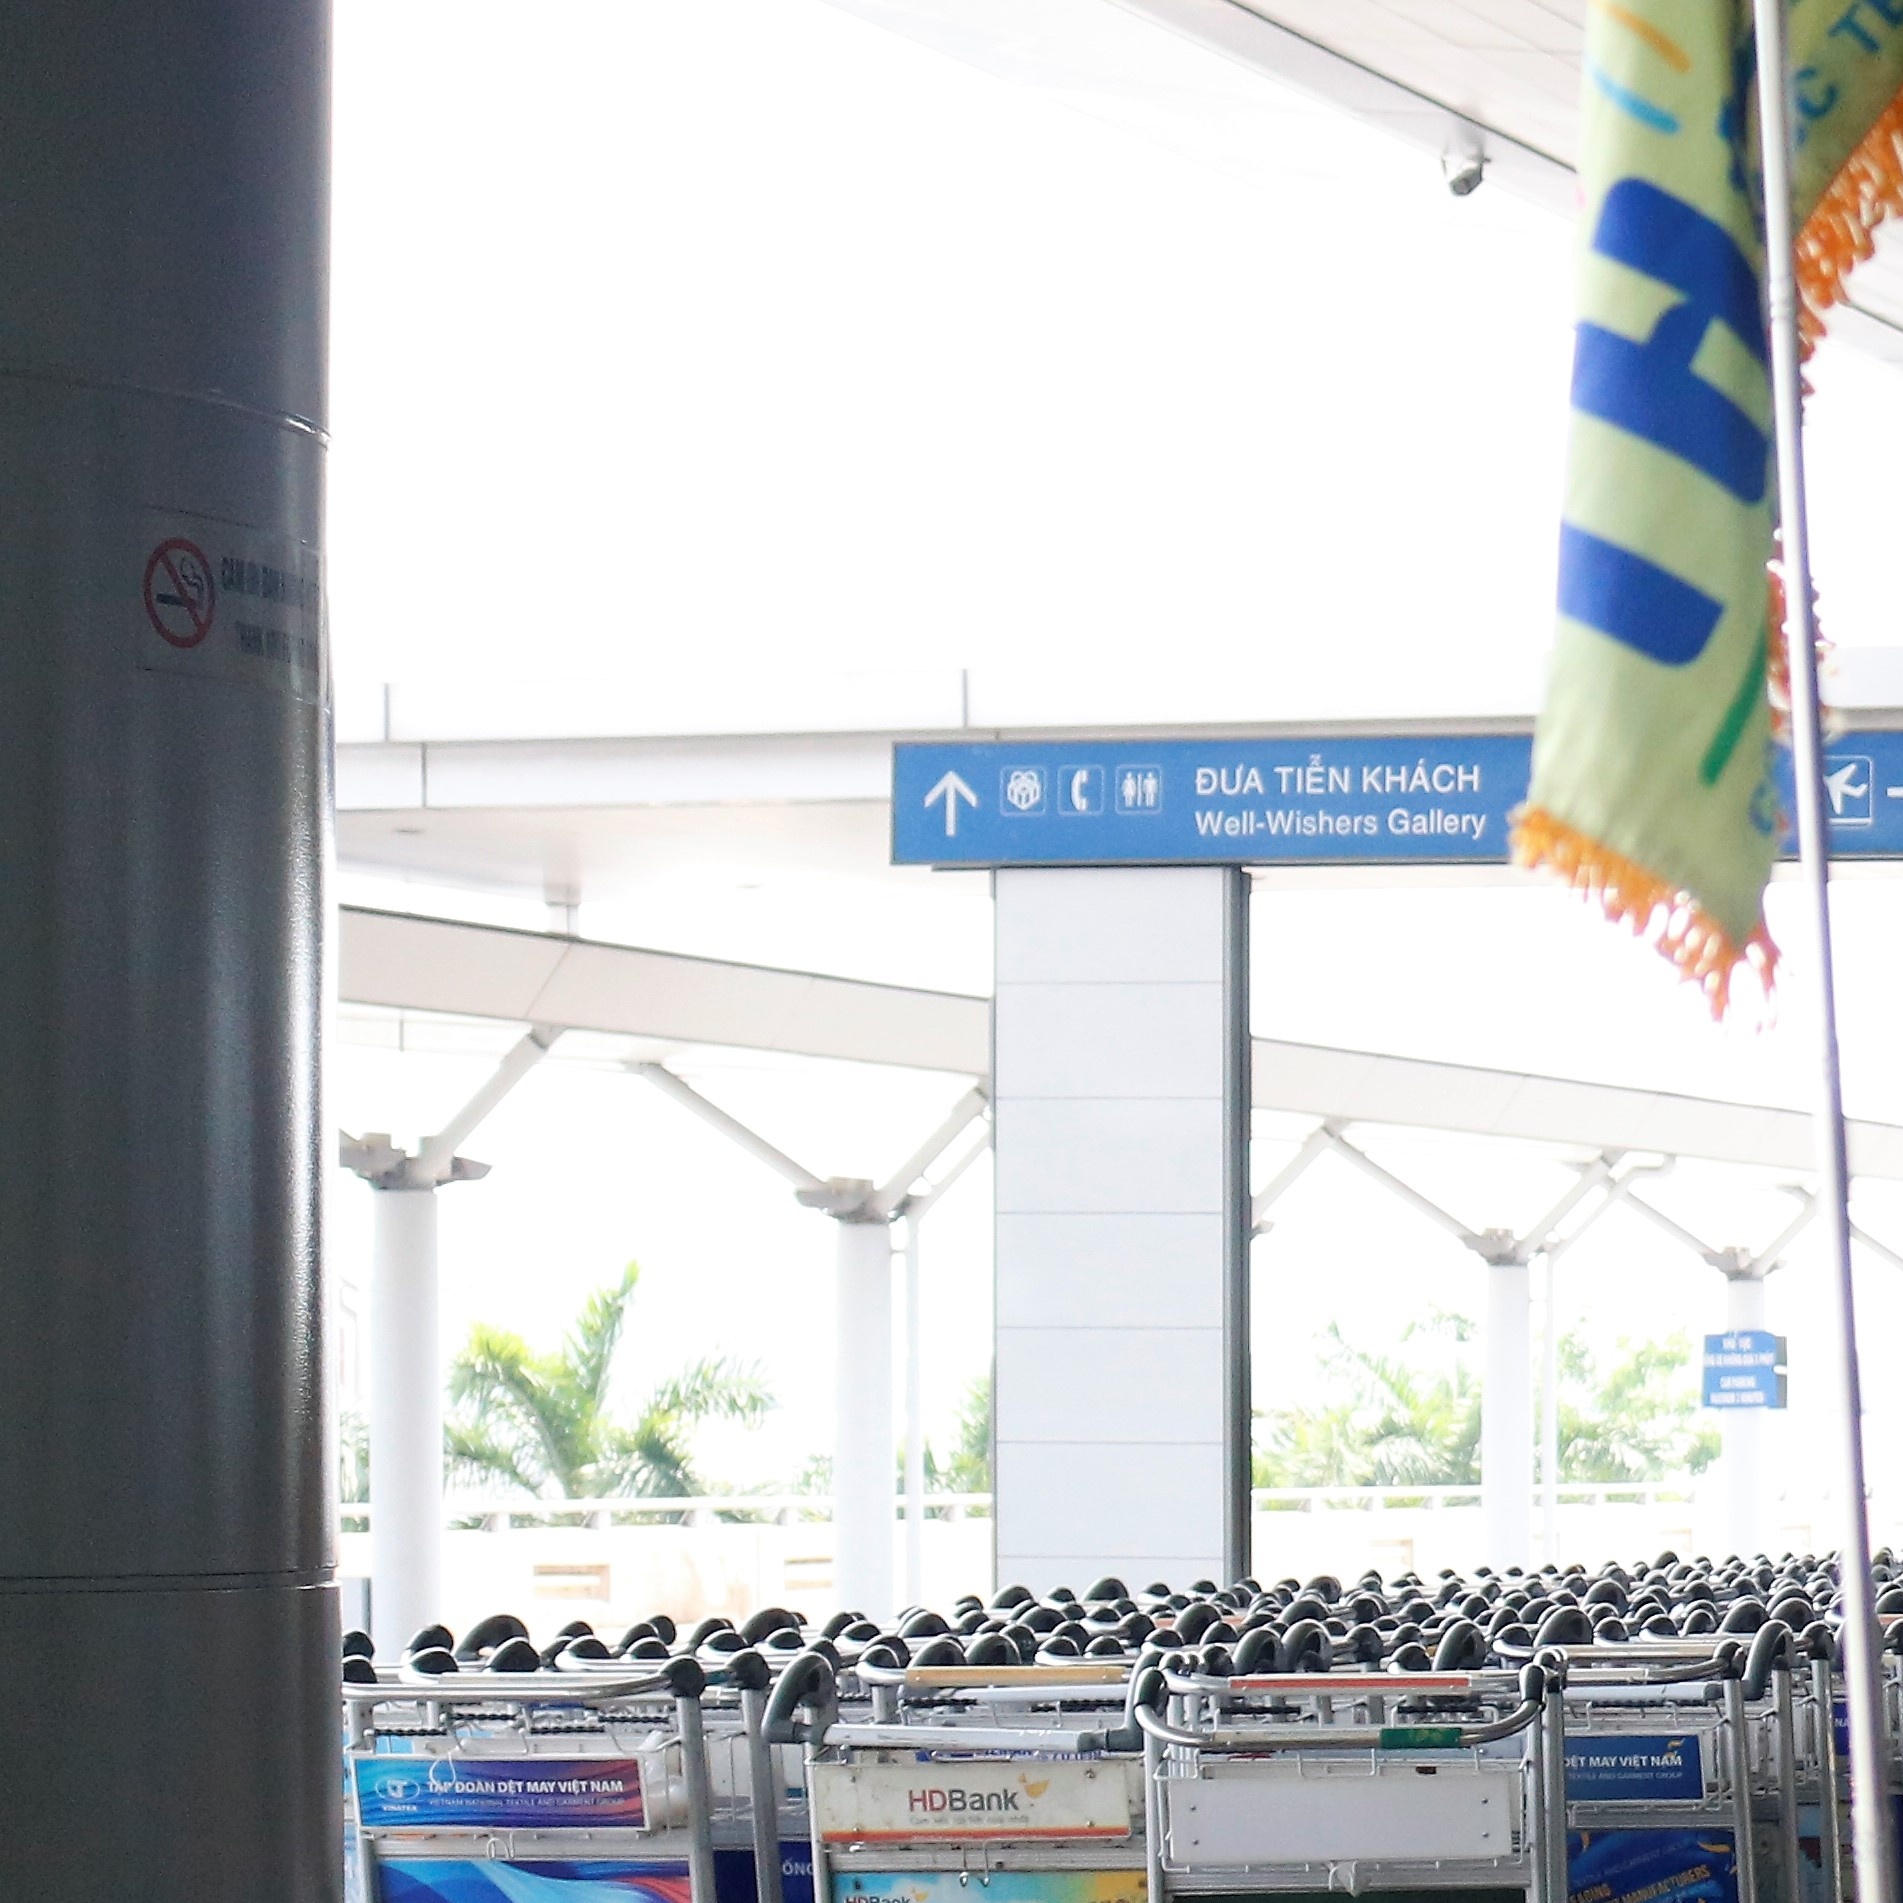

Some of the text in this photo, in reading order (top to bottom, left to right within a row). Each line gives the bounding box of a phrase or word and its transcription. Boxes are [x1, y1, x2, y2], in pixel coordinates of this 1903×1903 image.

[1195, 753, 1481, 795] ĐƯA TIỄN KHÁCH
[1195, 808, 1487, 840] Well-Wishers Gallery
[1589, 1755, 1617, 1767] MAY
[526, 1781, 558, 1793] MAY
[590, 1780, 624, 1793] NAM
[907, 1788, 1020, 1812] HDBank
